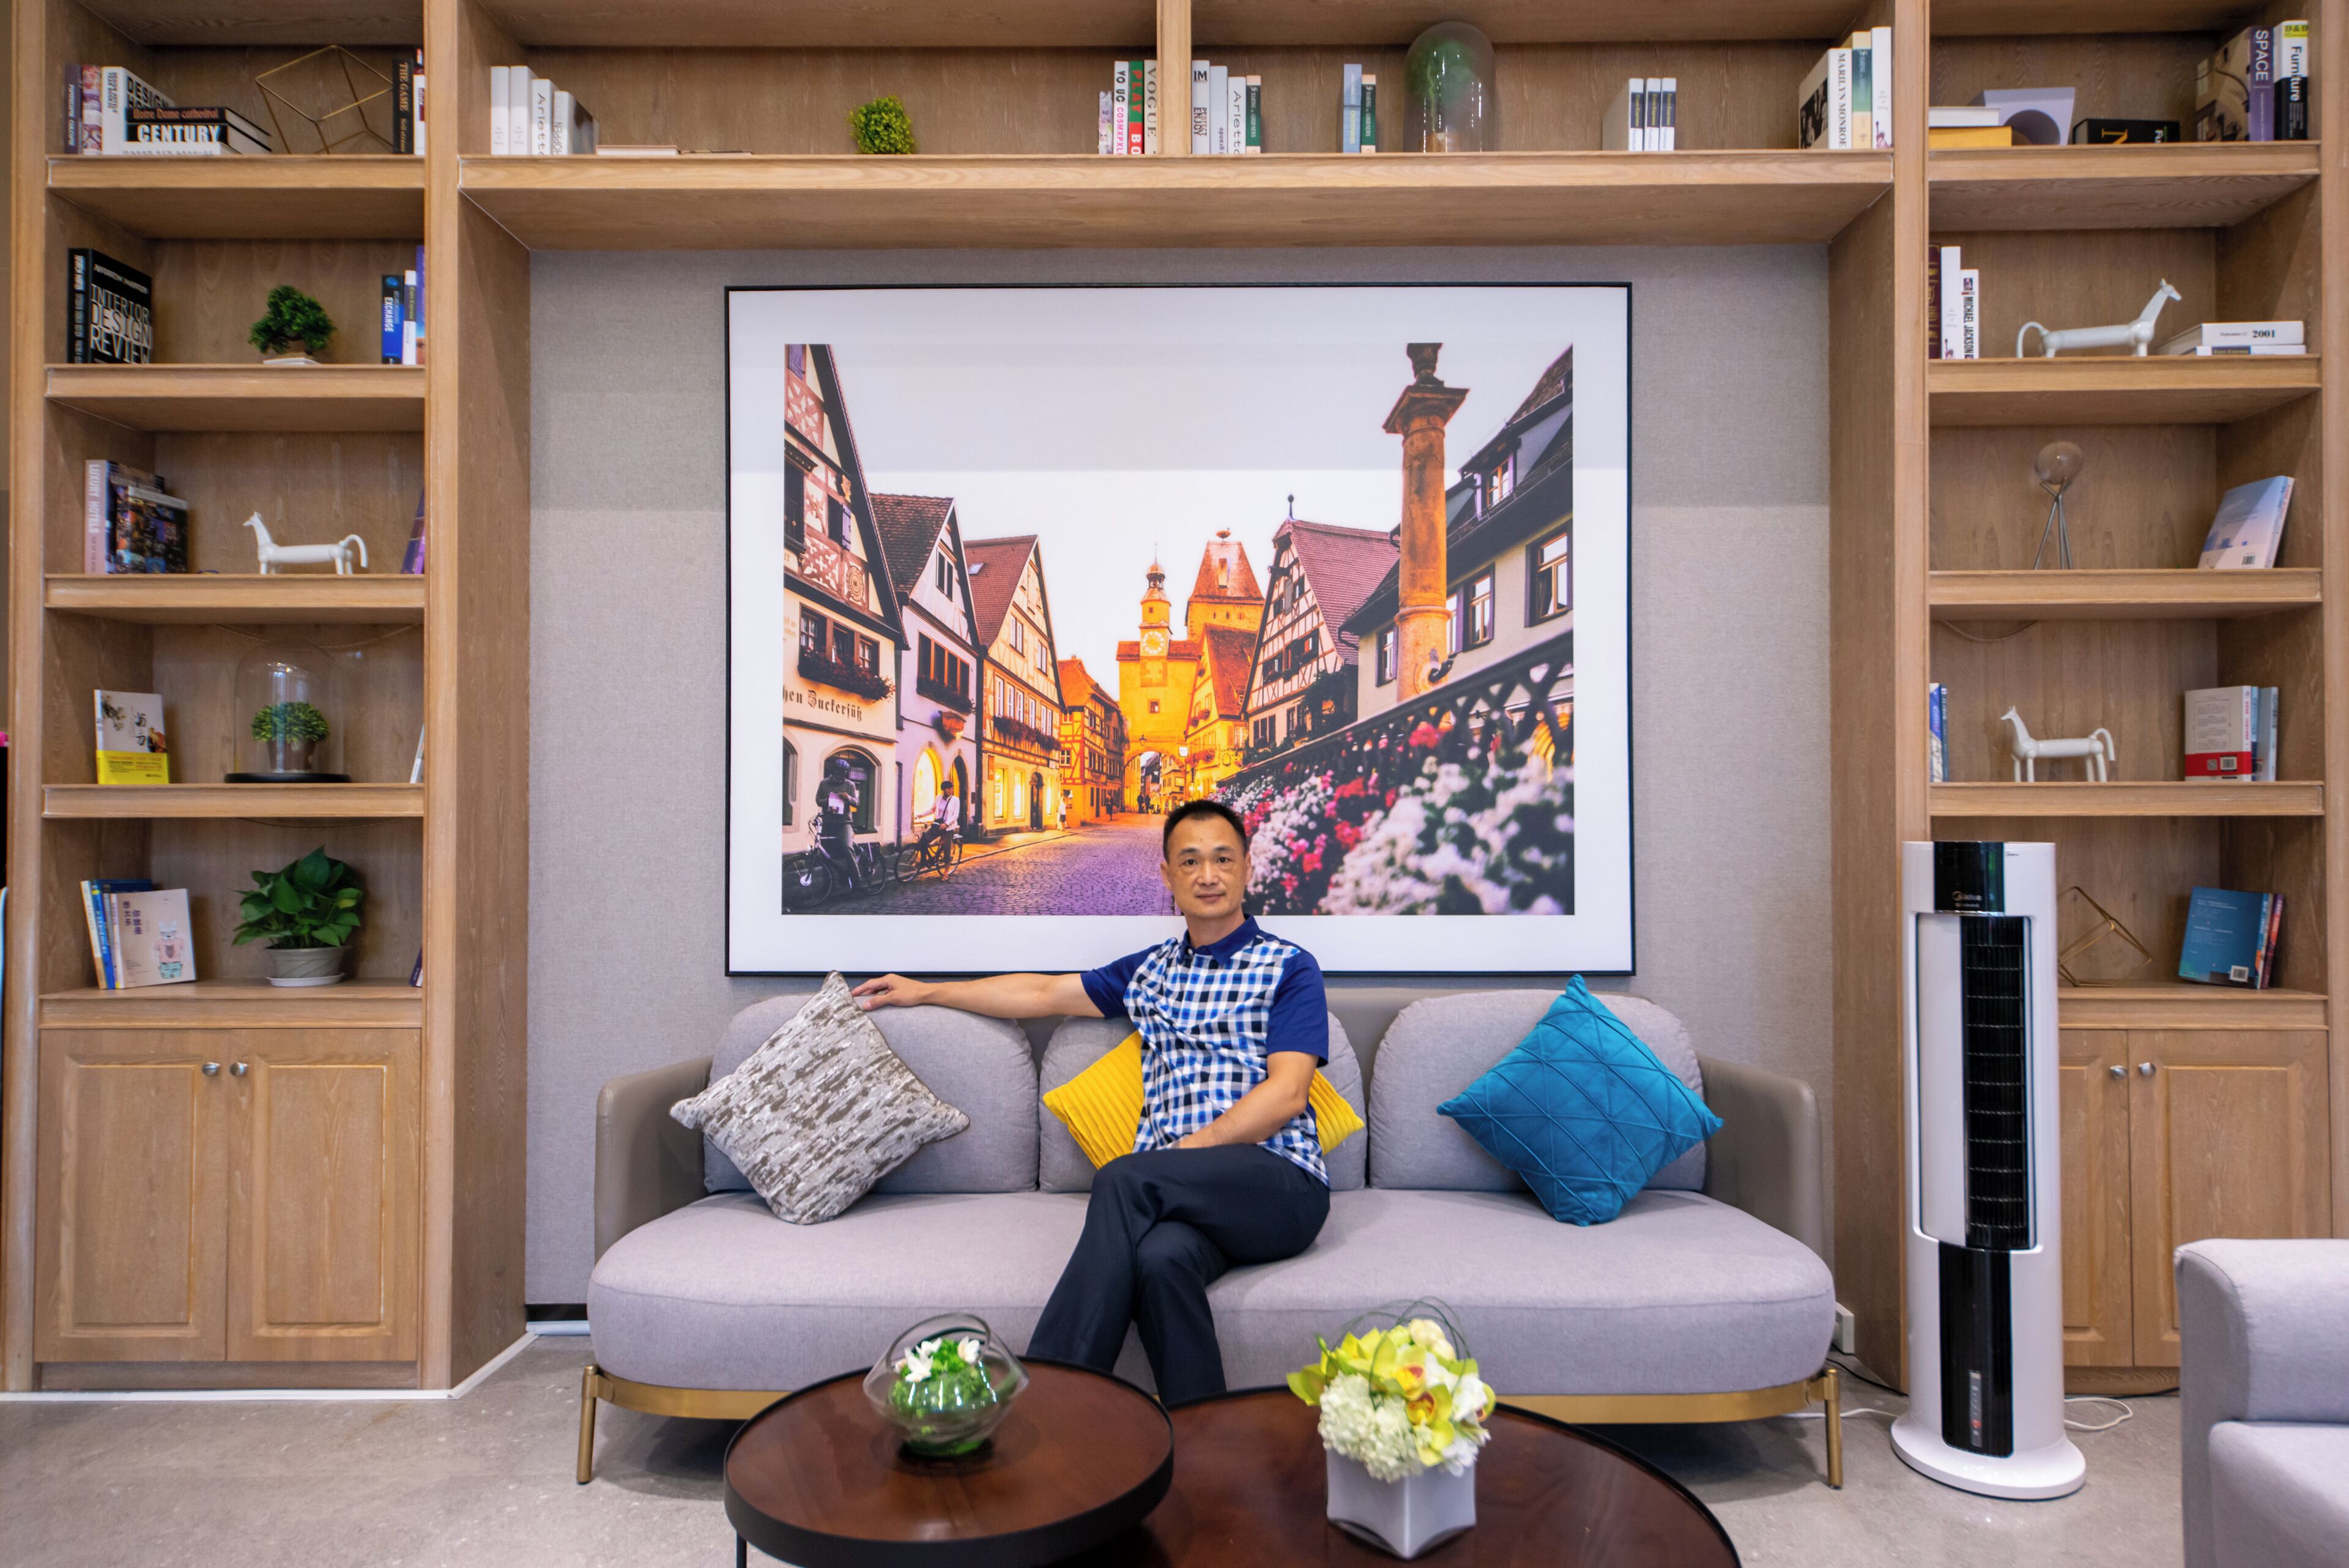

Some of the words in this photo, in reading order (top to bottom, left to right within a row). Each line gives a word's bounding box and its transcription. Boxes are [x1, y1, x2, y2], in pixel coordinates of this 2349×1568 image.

[2255, 30, 2269, 81] SPACE
[399, 62, 408, 82] THE
[1193, 70, 1207, 81] IM
[1838, 53, 1846, 101] MARILYN
[2290, 46, 2302, 101] Furniture
[127, 76, 171, 108] DESIGN
[399, 83, 409, 111] GAME
[1131, 70, 1142, 114] PLAY
[1147, 67, 1157, 137] VOGUE
[156, 108, 179, 119] Dame
[181, 108, 218, 119] cathedral
[1193, 107, 1202, 136] ENJOY
[1838, 103, 1847, 147] MONROE
[136, 124, 221, 143] CENTURY
[91, 283, 149, 325] INTERIOR
[384, 297, 394, 333] EXCHANGE
[1963, 296, 1974, 324] MICHAEL
[91, 299, 152, 349] DESIGN
[1963, 325, 1974, 354] JACKSON
[2252, 329, 2276, 338] 2001
[90, 323, 151, 364] REVIEW
[89, 464, 100, 497] LUXURY
[88, 502, 100, 534] HOTELS
